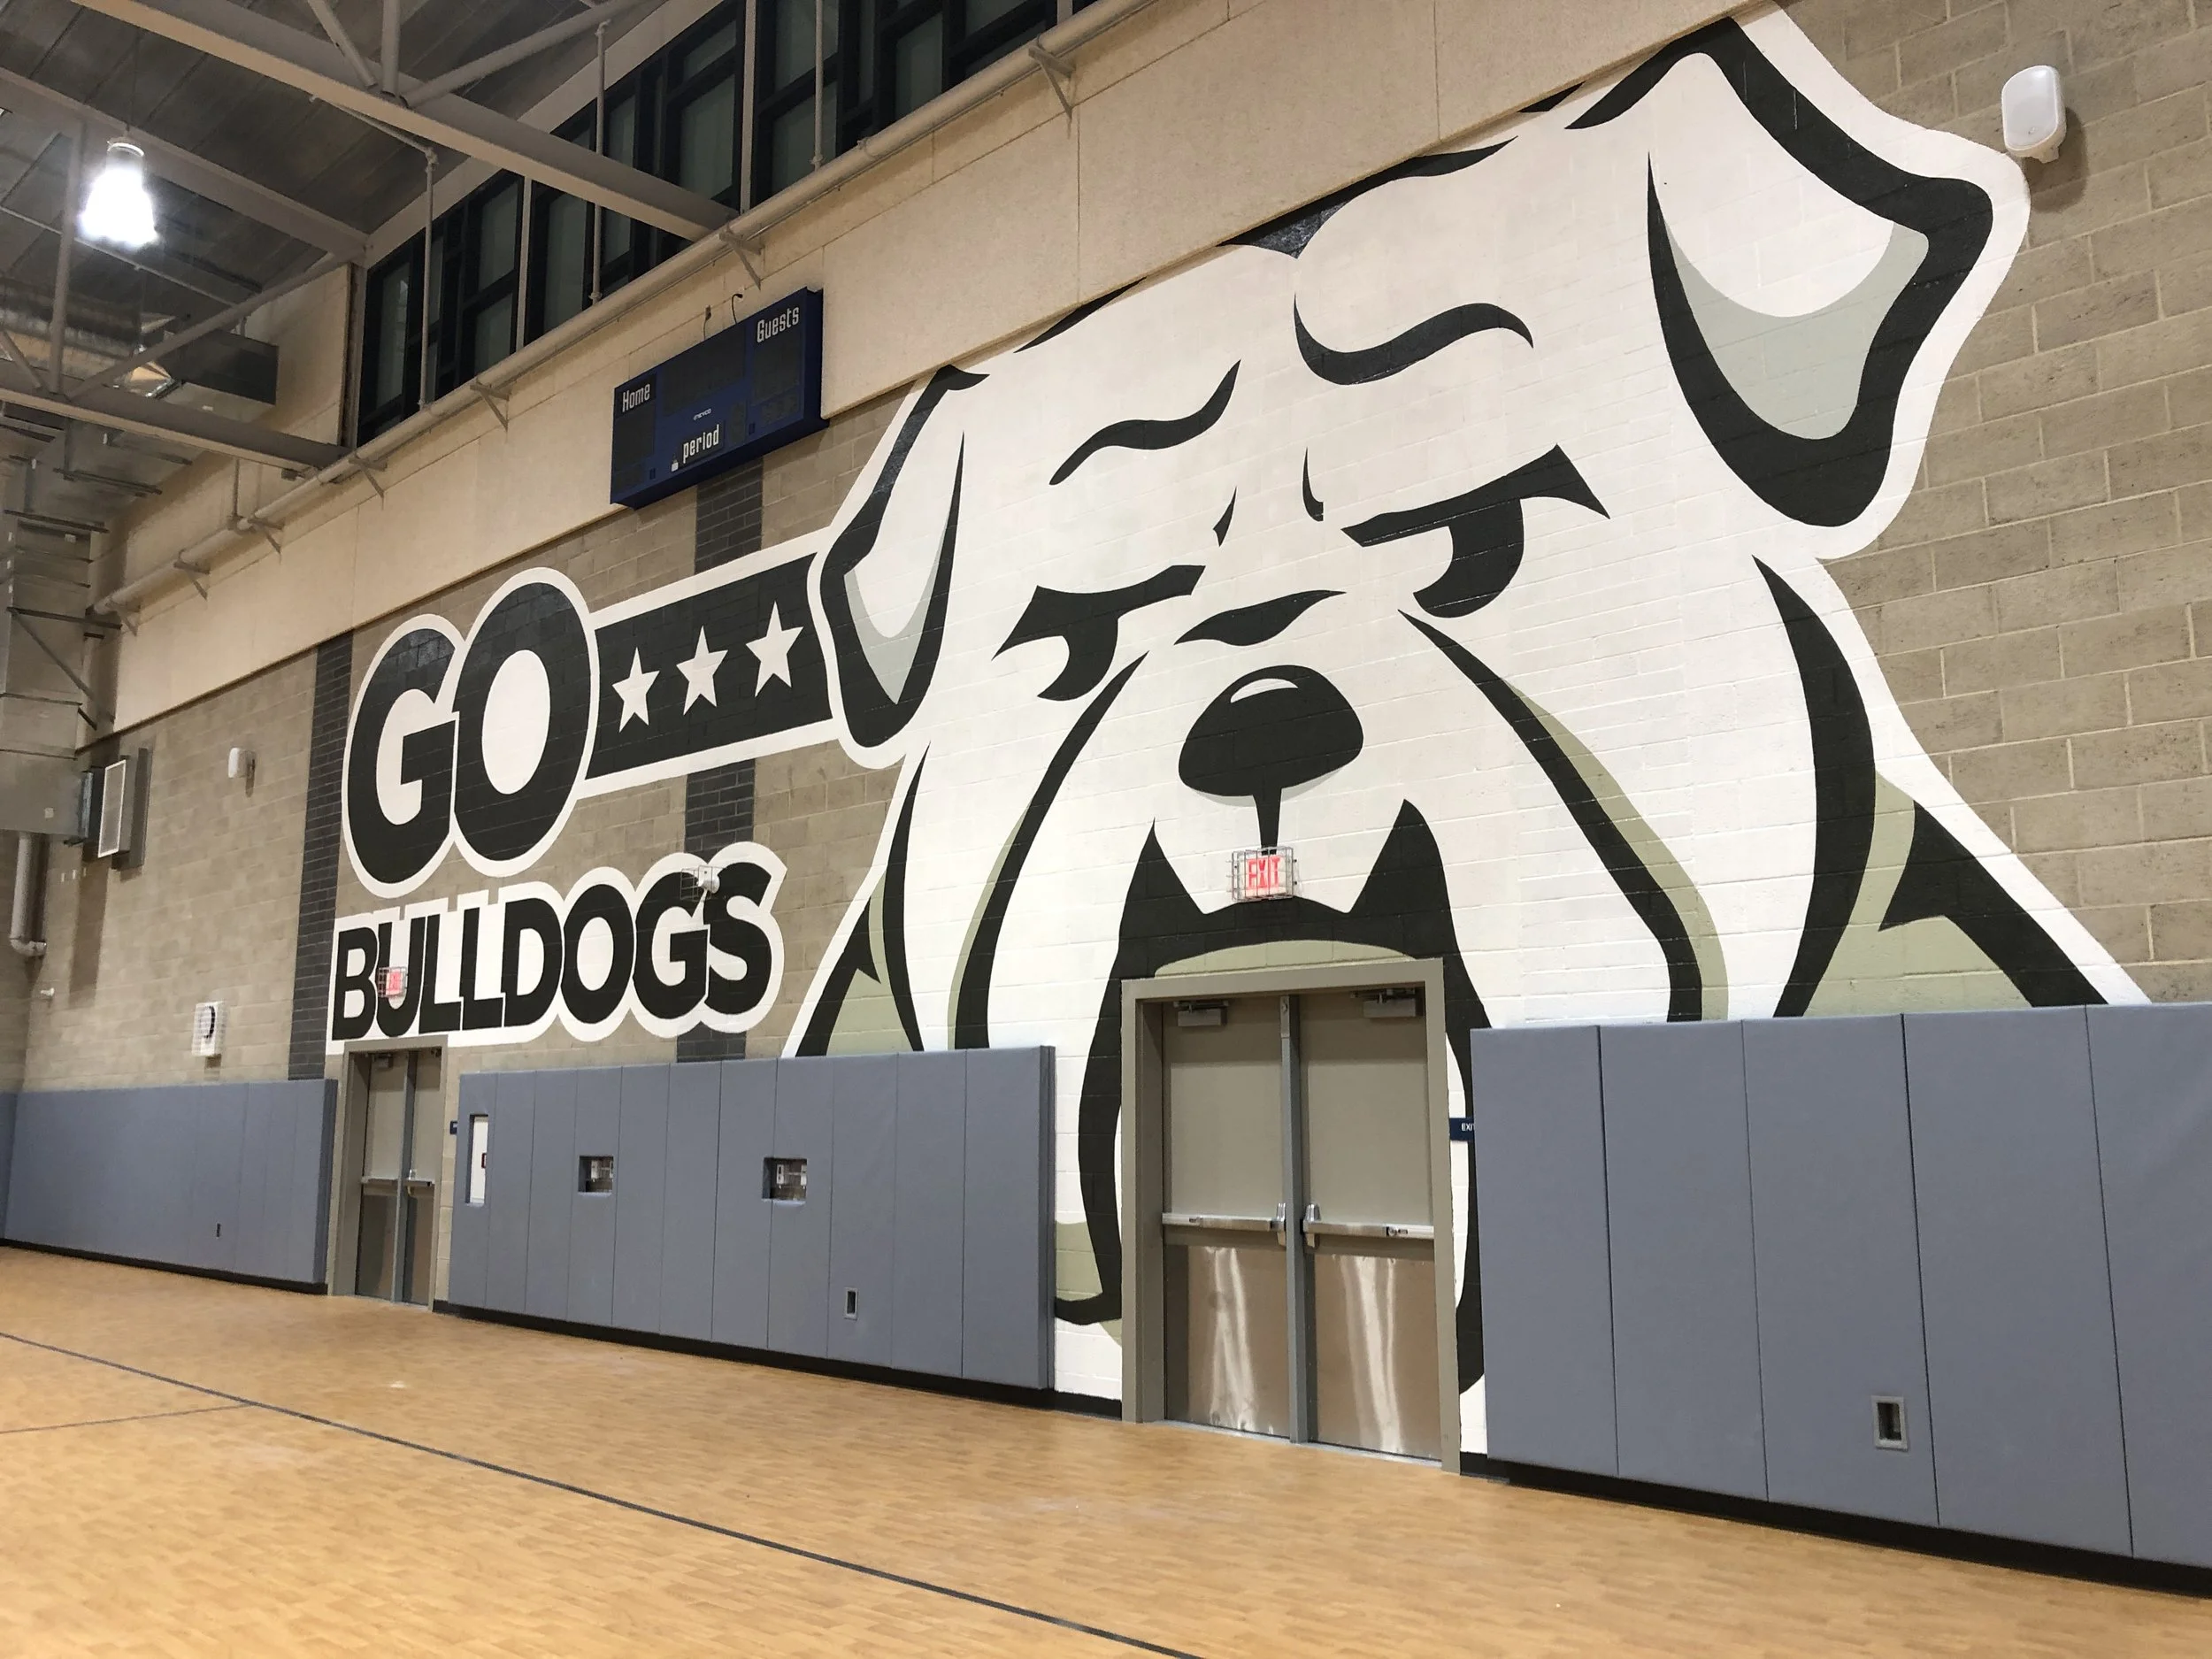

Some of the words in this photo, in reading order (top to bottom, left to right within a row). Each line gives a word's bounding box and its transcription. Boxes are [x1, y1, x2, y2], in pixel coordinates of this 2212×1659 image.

[757, 307, 799, 343] Guests
[622, 383, 650, 412] Home
[683, 424, 719, 464] period
[348, 581, 591, 885] GO
[1248, 856, 1280, 889] EXIT
[332, 862, 773, 1041] BULLDOGS
